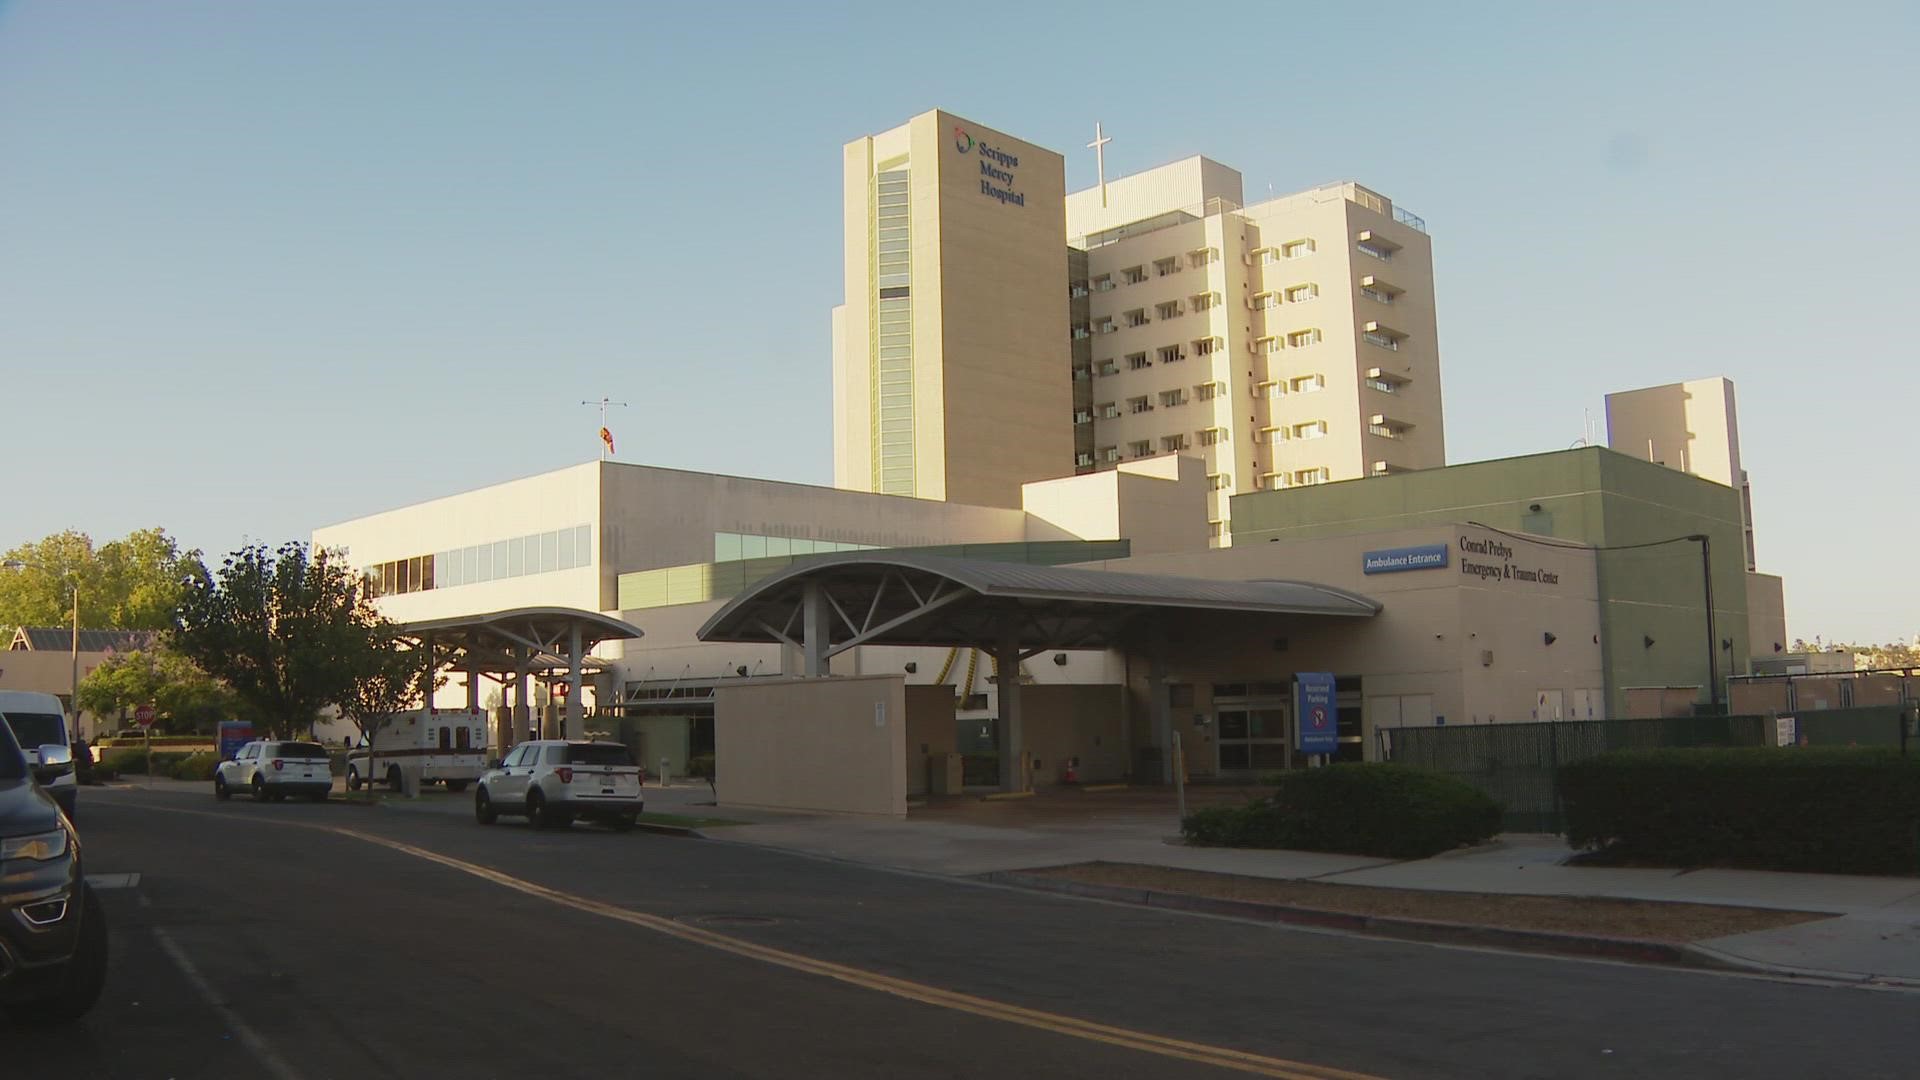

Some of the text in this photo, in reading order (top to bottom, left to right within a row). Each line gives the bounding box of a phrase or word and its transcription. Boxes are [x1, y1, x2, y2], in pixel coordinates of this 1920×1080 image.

[979, 142, 1018, 168] Scripps
[980, 159, 1013, 186] Mercy
[981, 179, 1024, 207] Hospital
[1367, 553, 1441, 569] Ambulance Entrance
[1460, 536, 1512, 561] Conrad Prebys
[1461, 558, 1559, 584] Emergency & Trauma Center
[1307, 694, 1329, 705] Parking
